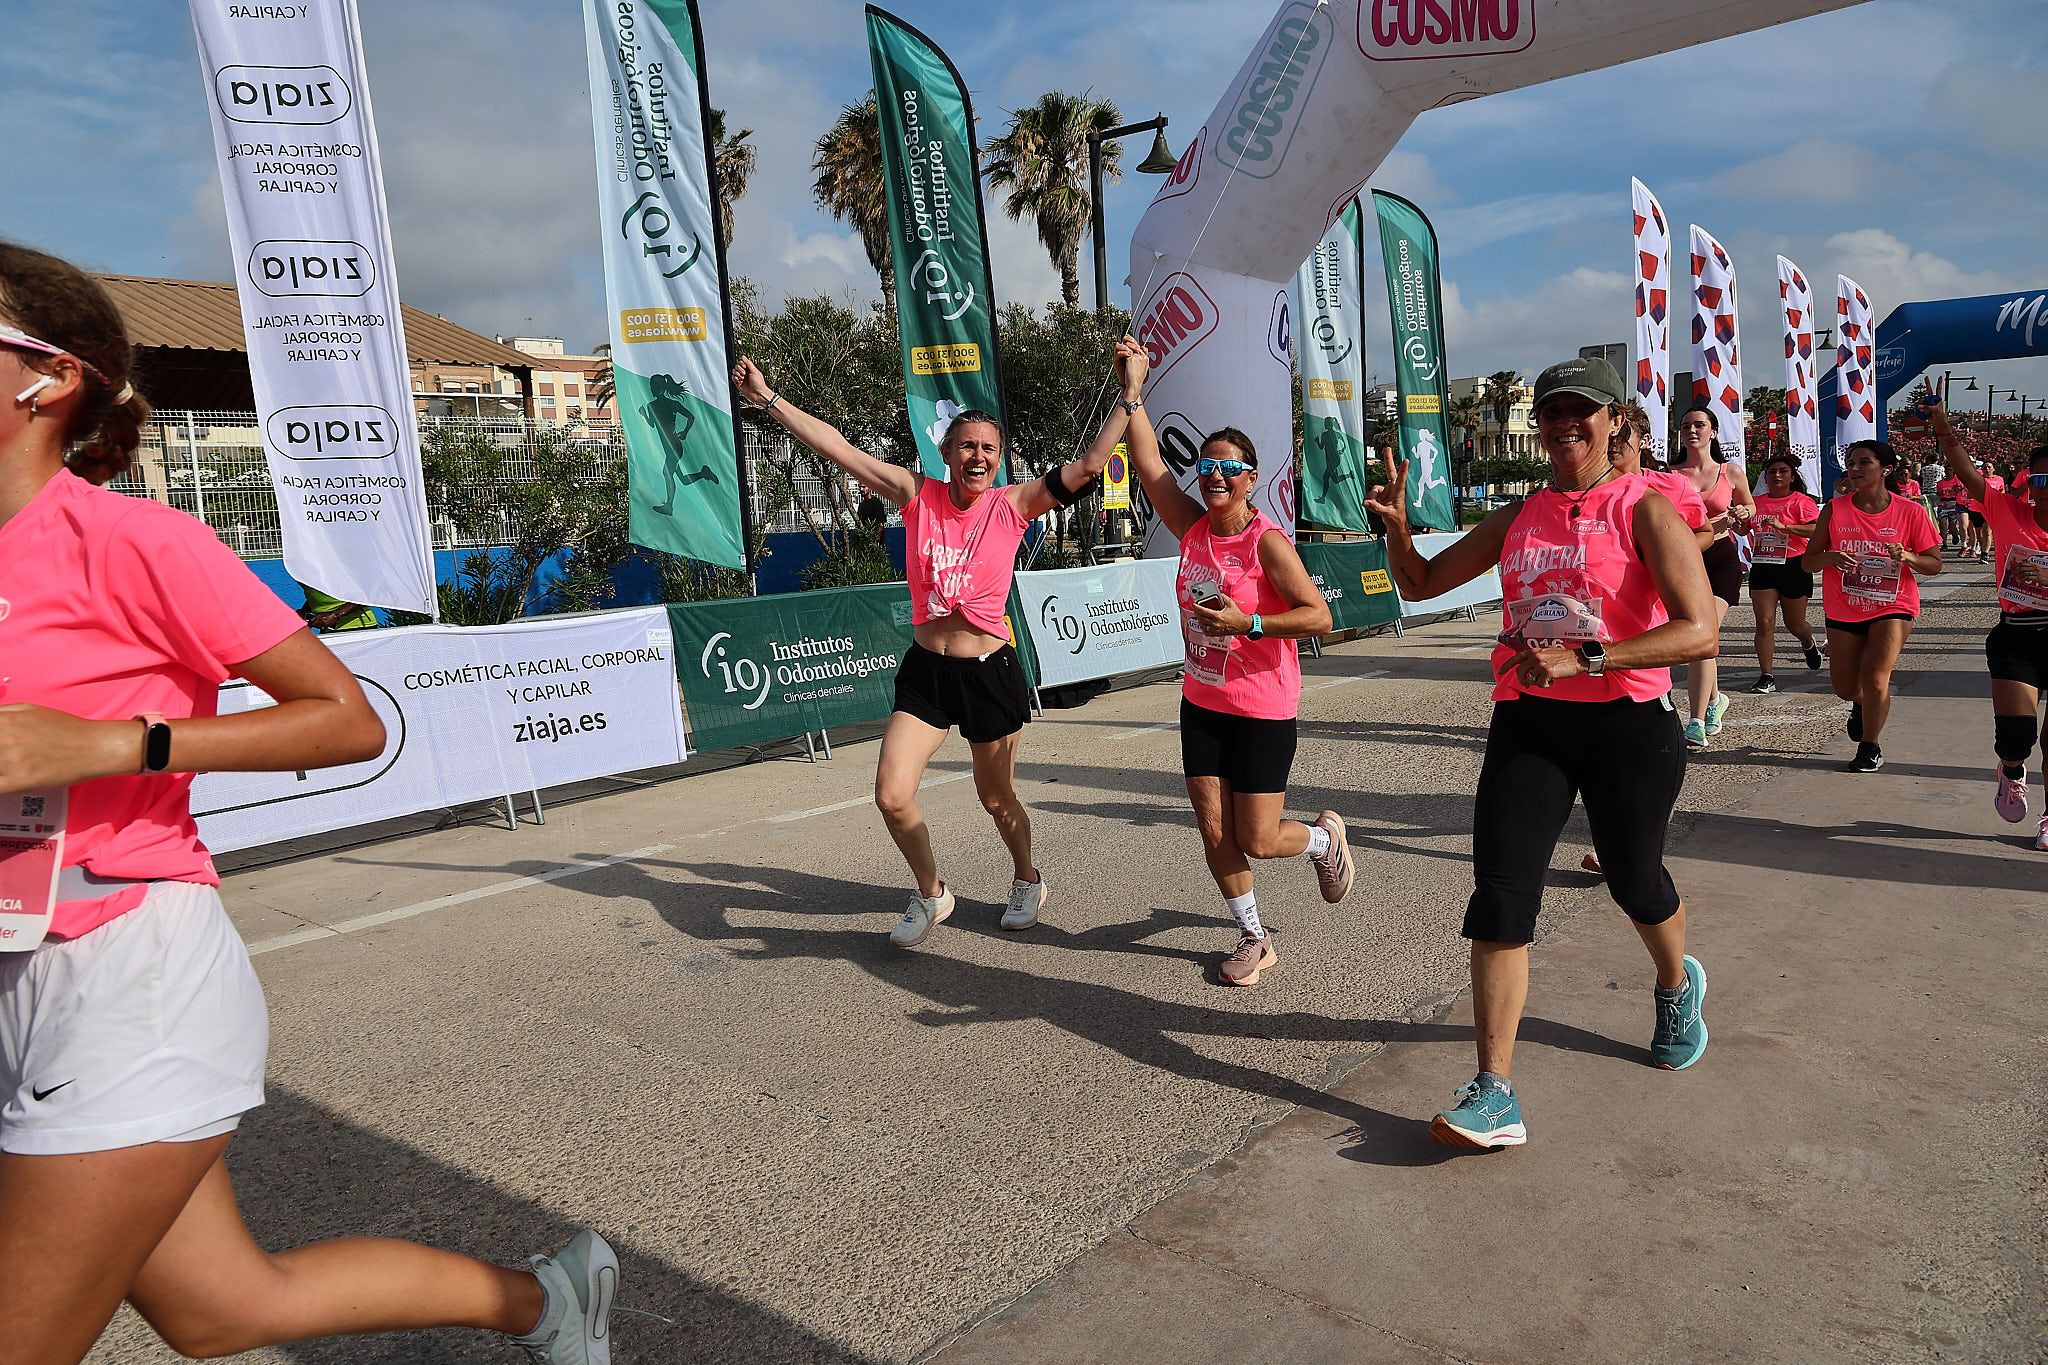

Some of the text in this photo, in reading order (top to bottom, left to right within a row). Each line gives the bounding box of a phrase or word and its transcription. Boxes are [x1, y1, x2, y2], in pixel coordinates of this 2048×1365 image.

[1371, 0, 1519, 47] COSMO
[1226, 17, 1320, 162] COSMO
[1875, 355, 1901, 368] arlene
[1503, 544, 1586, 575] CARRERA
[1860, 575, 1882, 584] 016
[1084, 598, 1140, 618] Institutos
[1090, 612, 1170, 637] Odontológicos
[769, 635, 854, 662] Institutos
[403, 646, 666, 692] COSMÉTICA FACIAL, CORPORAL
[776, 652, 897, 686] Odontológicos
[506, 679, 593, 704] Y CAPILAR
[783, 683, 854, 704] Clínicas dentales
[512, 708, 608, 744] ziaja.es
[0, 840, 53, 851] RREDORA
